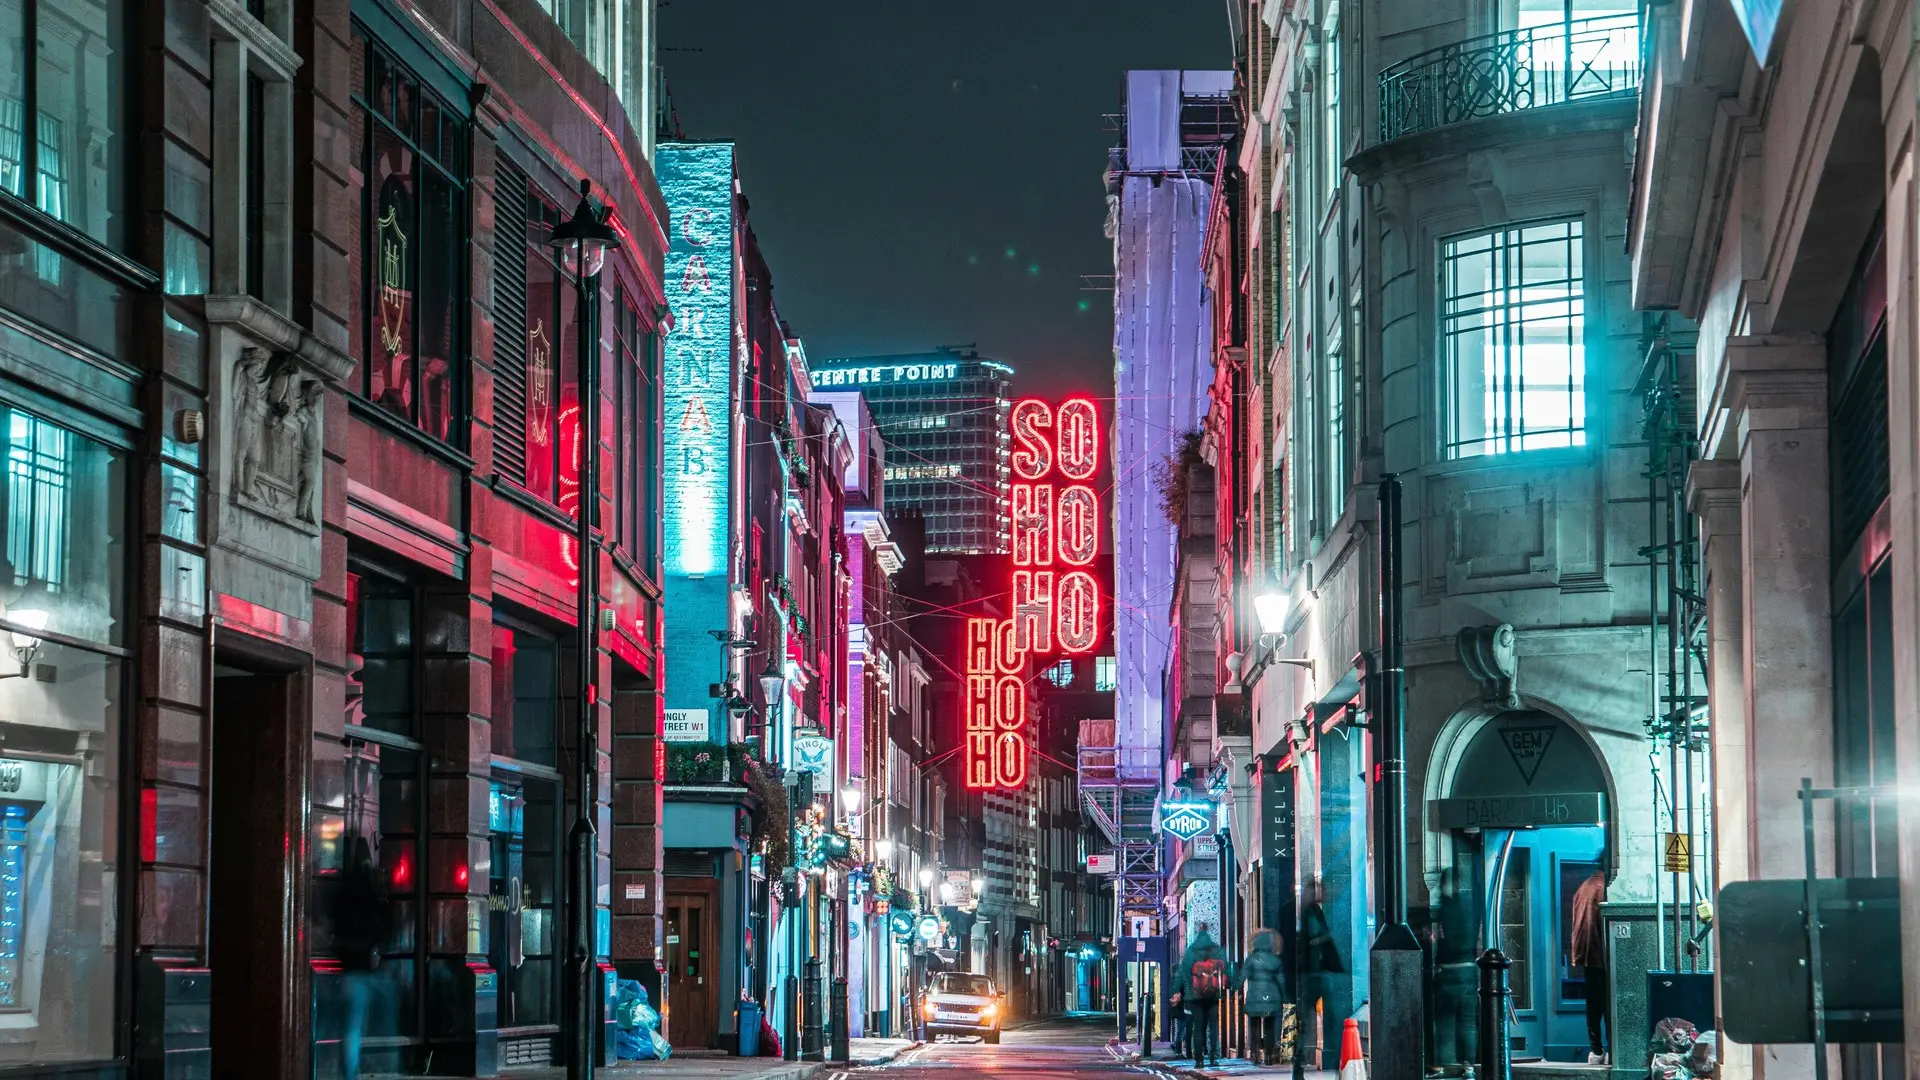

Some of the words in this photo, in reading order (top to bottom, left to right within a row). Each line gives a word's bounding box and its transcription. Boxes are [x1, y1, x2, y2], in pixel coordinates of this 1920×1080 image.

[680, 207, 713, 478] CARNAB
[811, 368, 881, 386] CENTRE
[893, 364, 957, 381] POINT
[1011, 398, 1099, 480] SO
[1011, 483, 1099, 567] HO
[1011, 570, 1099, 653] HO
[966, 617, 1026, 675] HO
[966, 674, 1026, 731] HO
[664, 712, 687, 721] INGLY
[664, 722, 689, 731] TREET
[691, 722, 704, 731] W1
[795, 740, 830, 752] KINGLY
[1512, 732, 1543, 750] GEM
[966, 730, 1026, 788] HO
[1169, 815, 1202, 834] BYRON
[1466, 798, 1502, 825] BAR
[1616, 926, 1628, 936] 10
